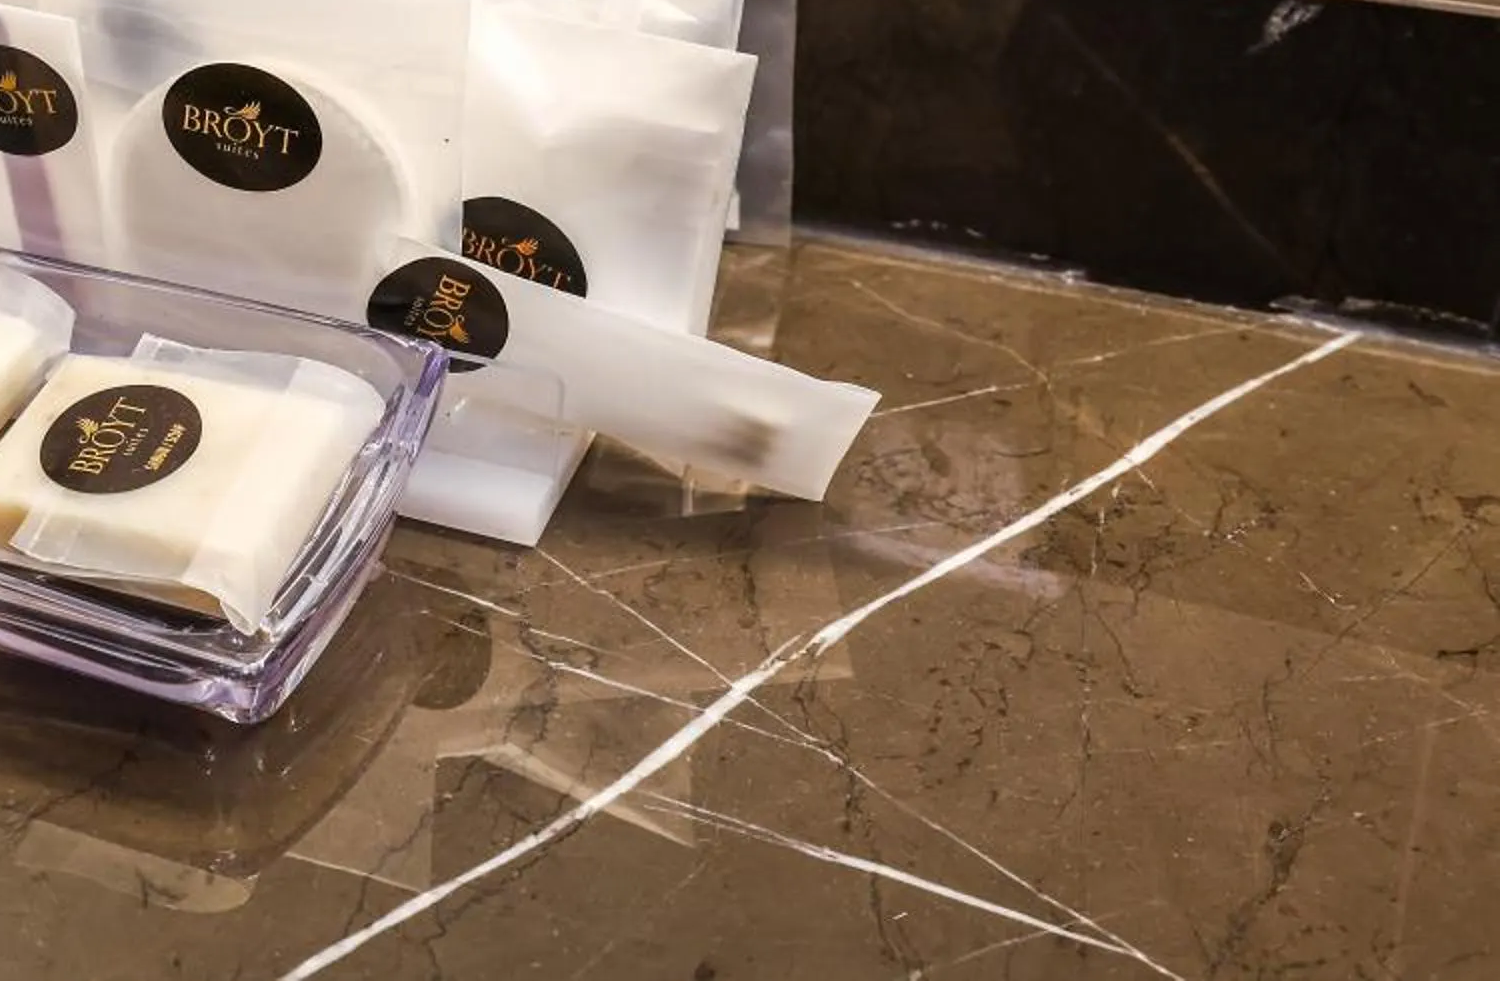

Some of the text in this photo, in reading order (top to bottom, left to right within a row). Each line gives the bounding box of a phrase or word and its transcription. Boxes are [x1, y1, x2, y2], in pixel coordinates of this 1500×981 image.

[182, 104, 299, 154] BROYT
[417, 274, 471, 342] BROY
[68, 396, 146, 475] BROYT
